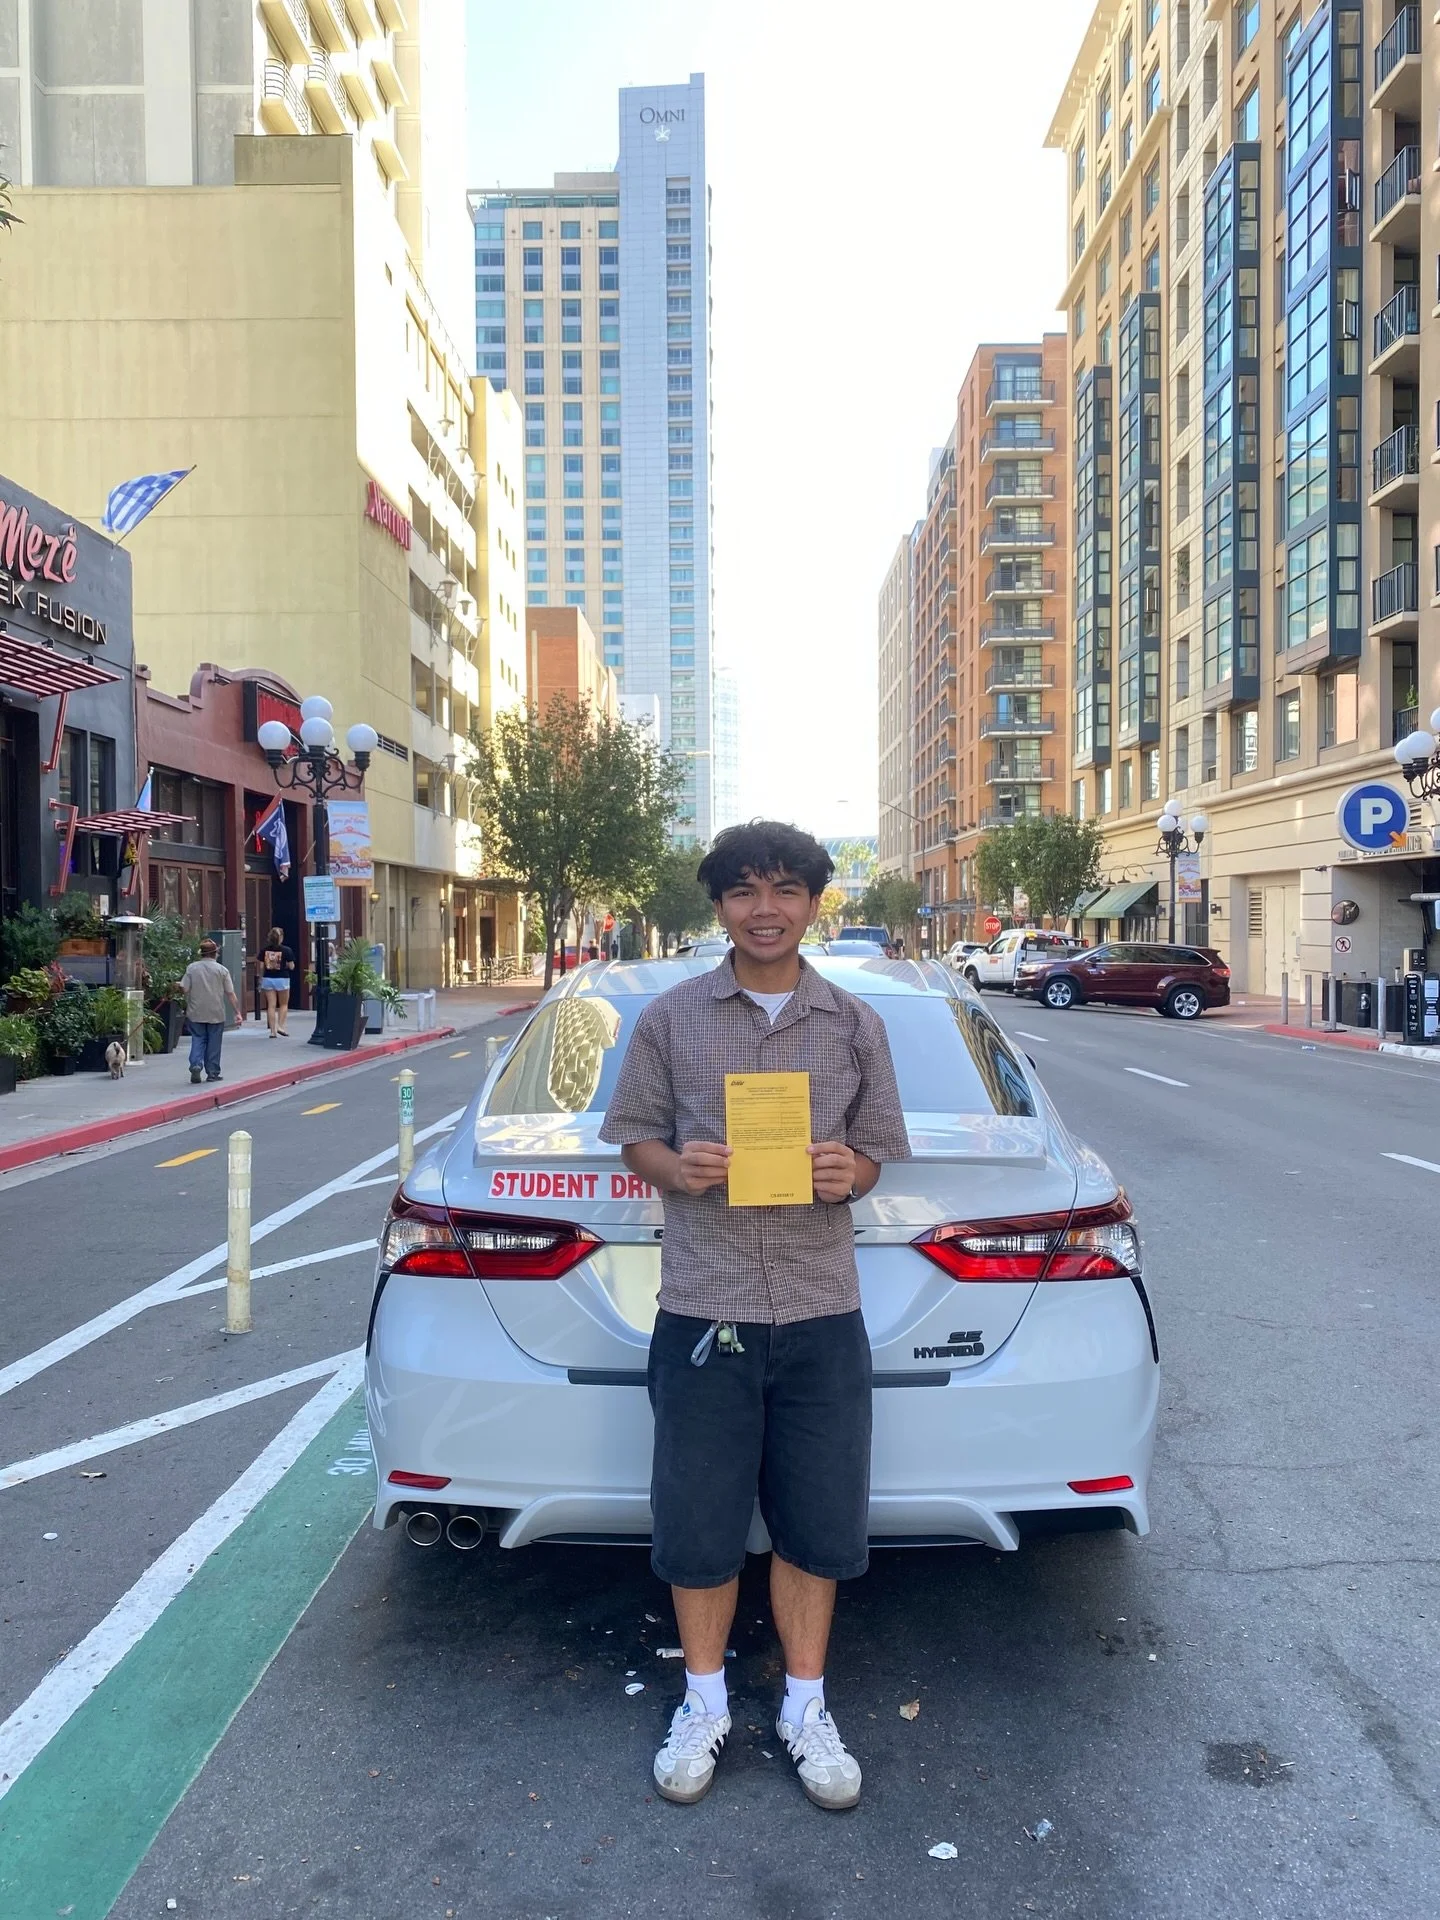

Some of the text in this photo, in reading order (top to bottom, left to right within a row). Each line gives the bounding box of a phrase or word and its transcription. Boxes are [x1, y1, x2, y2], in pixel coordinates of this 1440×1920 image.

[37, 592, 107, 644] FUSION
[1360, 797, 1393, 835] P
[985, 922, 1000, 931] STOP
[402, 1087, 411, 1099] 30
[491, 1172, 662, 1199] STUDENT DRI
[947, 1330, 983, 1344] SE
[913, 1345, 974, 1359] HYBRID
[327, 1457, 373, 1476] 30
